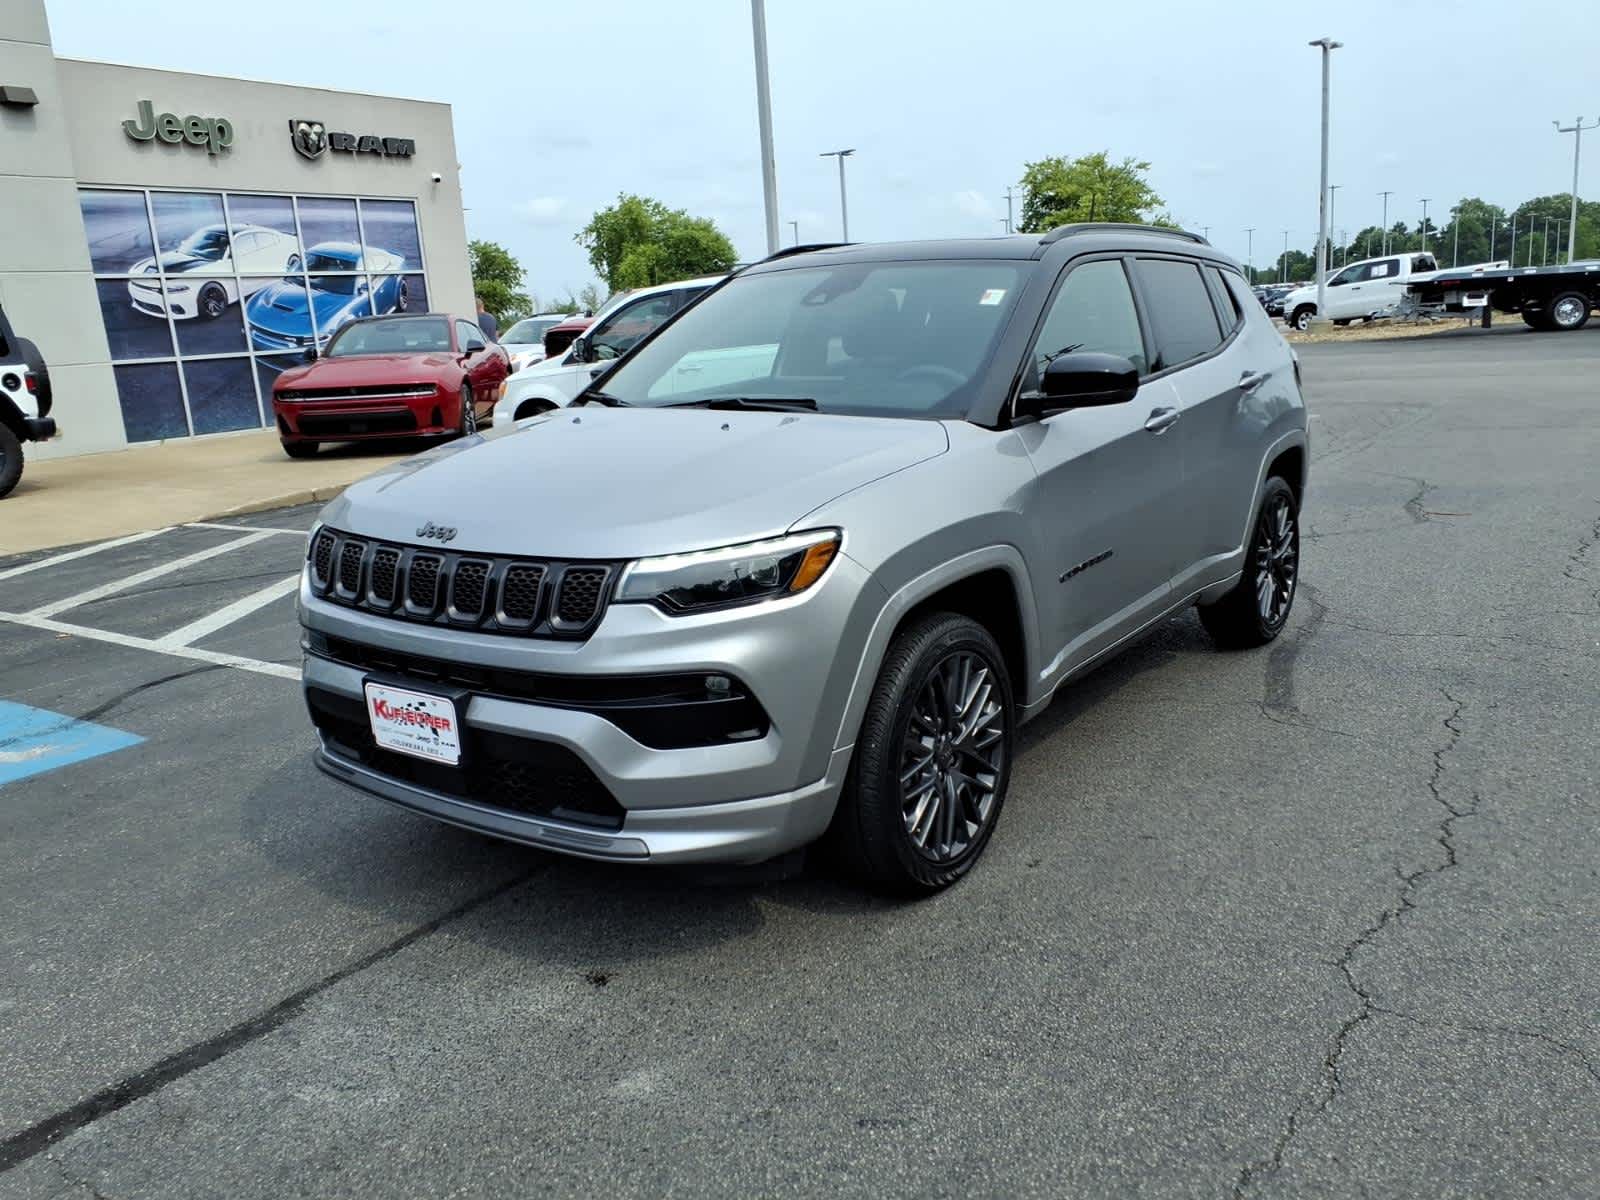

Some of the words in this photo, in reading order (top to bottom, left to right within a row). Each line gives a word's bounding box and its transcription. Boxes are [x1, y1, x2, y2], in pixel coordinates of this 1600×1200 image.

[122, 100, 234, 154] Jeep
[328, 131, 416, 157] RAM
[416, 520, 457, 544] Jeep
